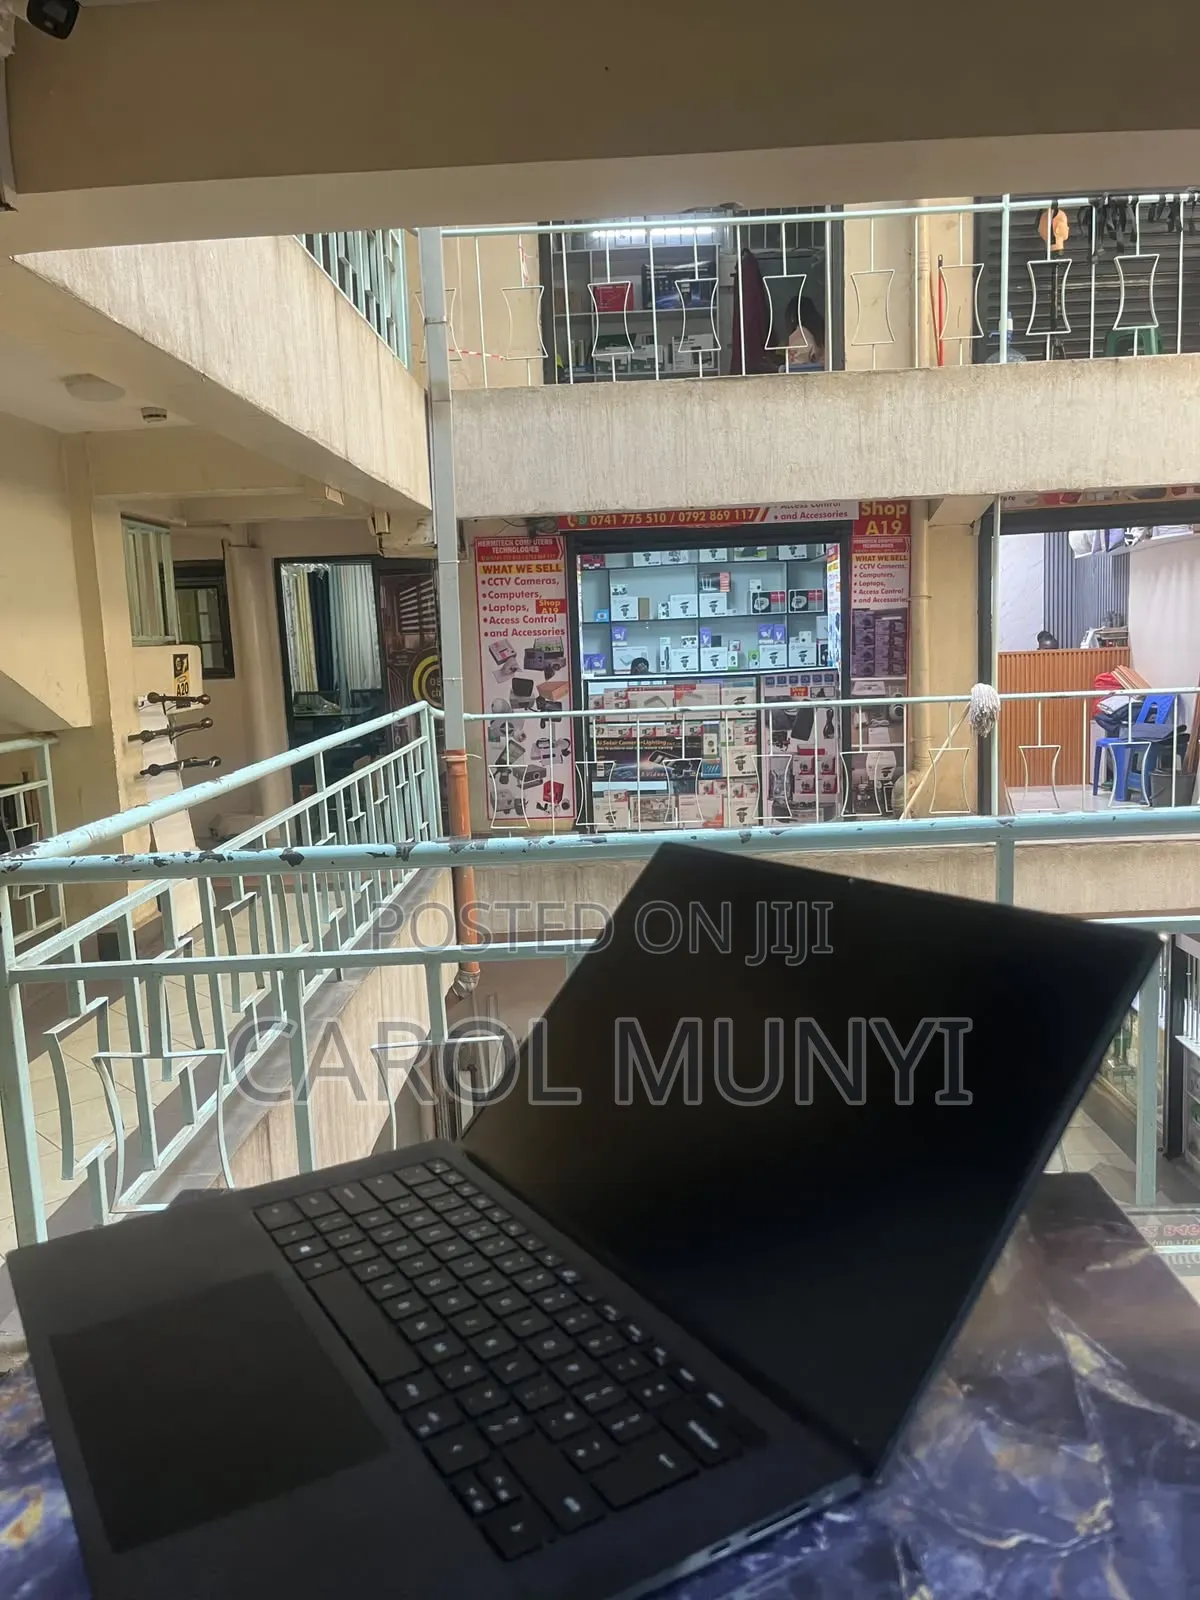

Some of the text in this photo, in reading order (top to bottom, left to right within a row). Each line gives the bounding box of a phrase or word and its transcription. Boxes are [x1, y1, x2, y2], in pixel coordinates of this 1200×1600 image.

[781, 510, 848, 520] and Accessories
[861, 501, 907, 519] Shop
[590, 515, 617, 526] 0741
[622, 514, 643, 524] 775
[646, 513, 666, 523] 510
[679, 511, 706, 521] 0792
[709, 510, 730, 521] 869
[735, 509, 754, 520] 117
[866, 520, 902, 535] A19
[483, 564, 562, 574] WHAT WE SELL
[487, 577, 560, 586] CCTV Cameras,
[488, 590, 542, 600] Computers,
[538, 599, 560, 607] Shop
[488, 604, 529, 613] Laptops,
[489, 615, 557, 625] Access Control
[490, 627, 565, 637] and Accessories
[177, 682, 189, 697] A20
